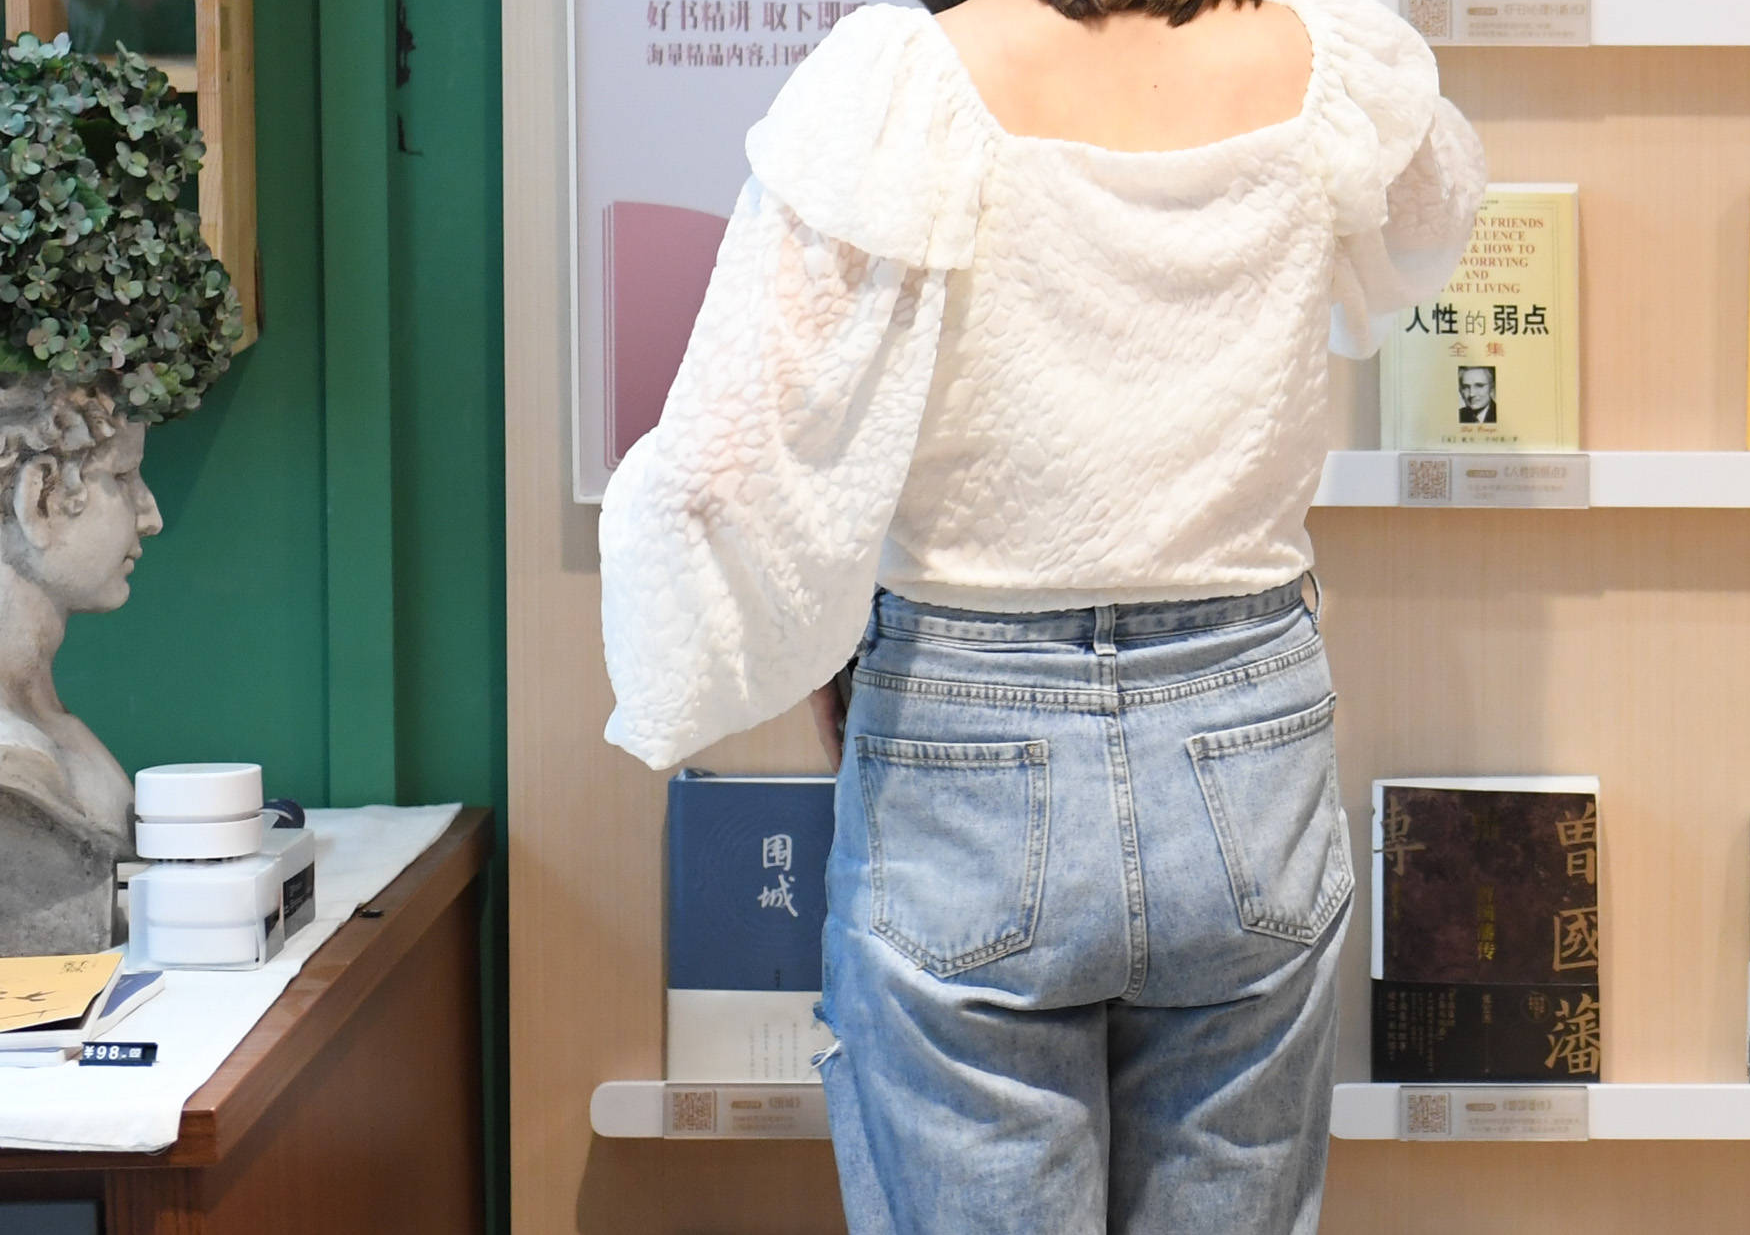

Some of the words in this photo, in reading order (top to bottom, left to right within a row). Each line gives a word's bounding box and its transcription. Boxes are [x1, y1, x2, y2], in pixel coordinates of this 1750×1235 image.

[647, 0, 750, 32] 好书精讲
[763, 0, 867, 32] 取下即
[1490, 216, 1544, 229] FRIENDS
[1474, 230, 1526, 242] LUENCE
[1483, 244, 1514, 255] HOW
[1518, 244, 1535, 255] TO
[1464, 269, 1489, 281] AND
[1446, 282, 1472, 294] ART
[1475, 282, 1520, 294] LIVING
[1405, 303, 1549, 336] 人性的弱点
[1450, 342, 1505, 358] 全集
[758, 834, 799, 917] 围城
